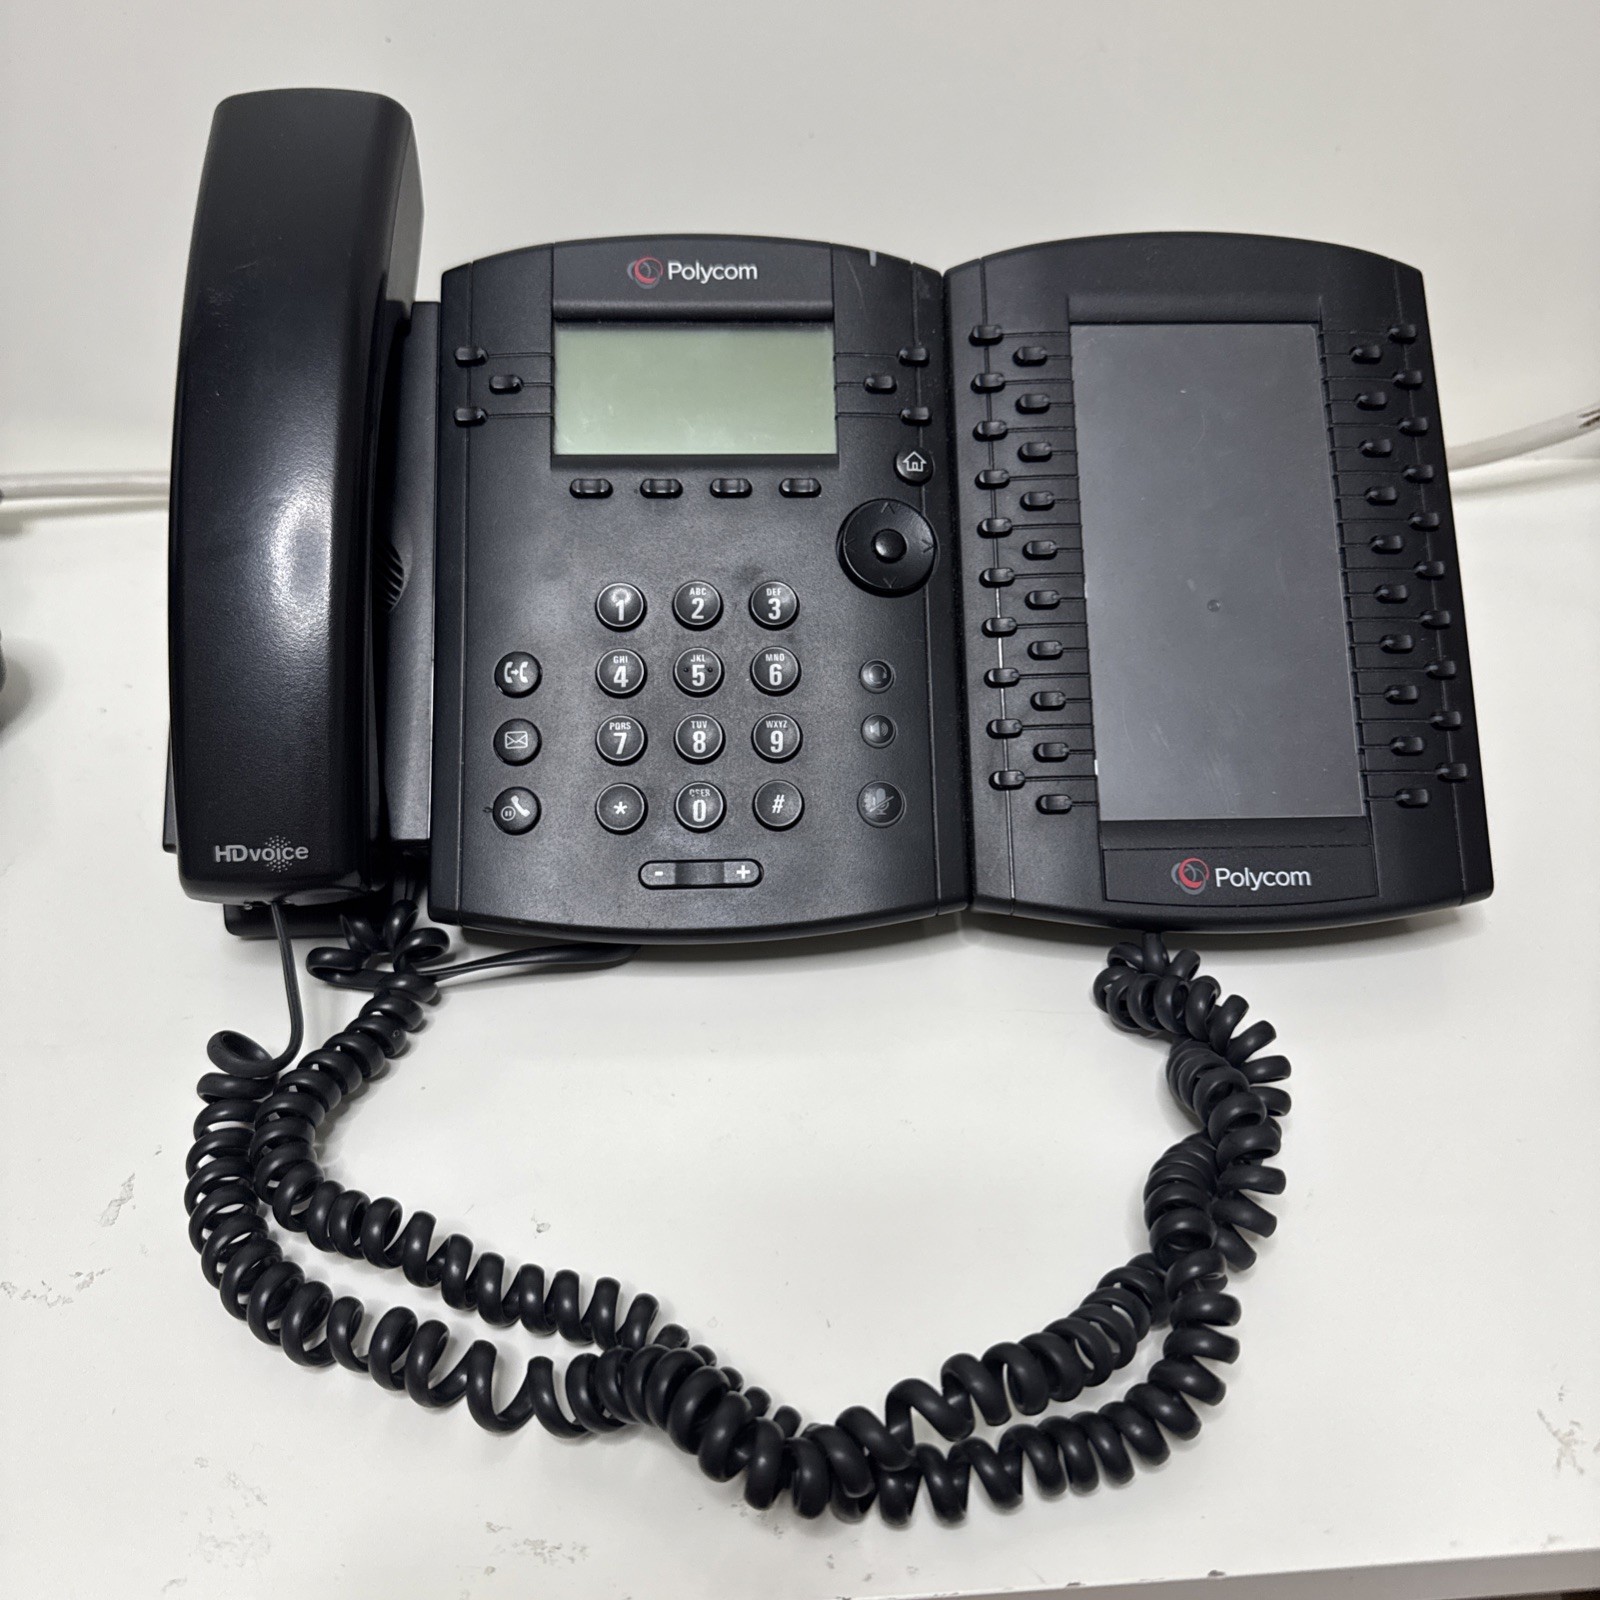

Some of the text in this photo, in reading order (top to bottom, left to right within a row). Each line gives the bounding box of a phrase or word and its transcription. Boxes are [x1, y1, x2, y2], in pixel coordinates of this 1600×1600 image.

[667, 260, 758, 284] Polycom
[689, 588, 707, 596] ABC
[766, 588, 782, 597] DEF
[615, 599, 625, 621] 1
[691, 597, 705, 620] 2
[768, 597, 781, 620] 3
[613, 655, 628, 664] GHI
[690, 655, 706, 663] JKL
[765, 653, 785, 662] MNO
[613, 665, 629, 688] 4
[692, 664, 706, 687] 5
[769, 663, 783, 686] 6
[609, 722, 632, 731] PQRS
[691, 720, 708, 729] TUV
[765, 720, 788, 729] WXYZ
[613, 732, 628, 755] 7
[692, 730, 707, 754] 8
[770, 730, 784, 753] 9
[692, 799, 707, 823] 0
[1214, 866, 1312, 892] Polycom
